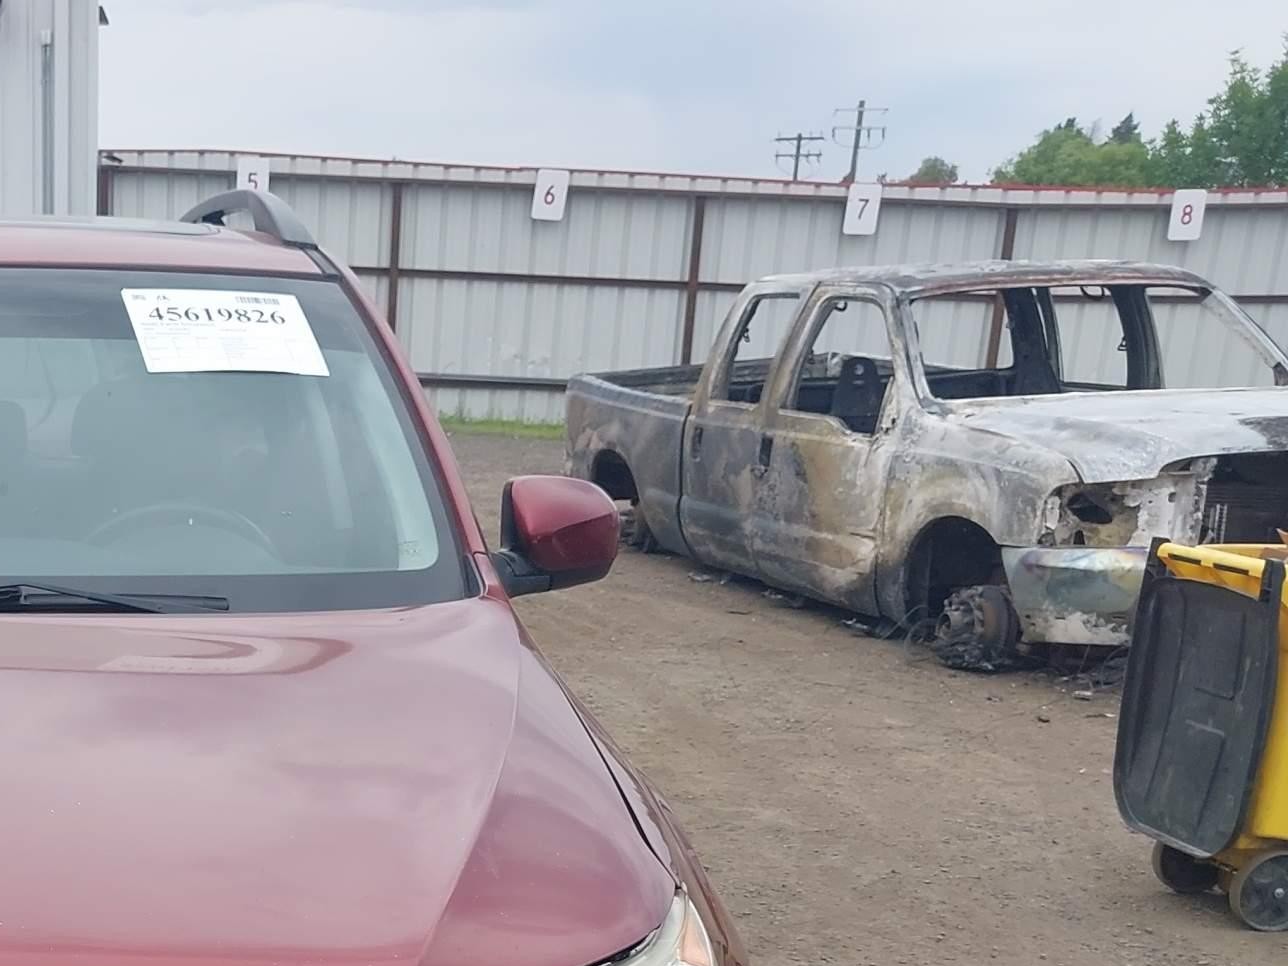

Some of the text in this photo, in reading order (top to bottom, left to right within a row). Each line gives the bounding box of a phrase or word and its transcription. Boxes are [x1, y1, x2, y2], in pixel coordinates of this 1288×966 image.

[248, 172, 258, 190] 5
[544, 185, 555, 205] 6
[858, 198, 870, 220] 7
[1181, 204, 1193, 225] 8
[148, 306, 286, 325] 45619826
